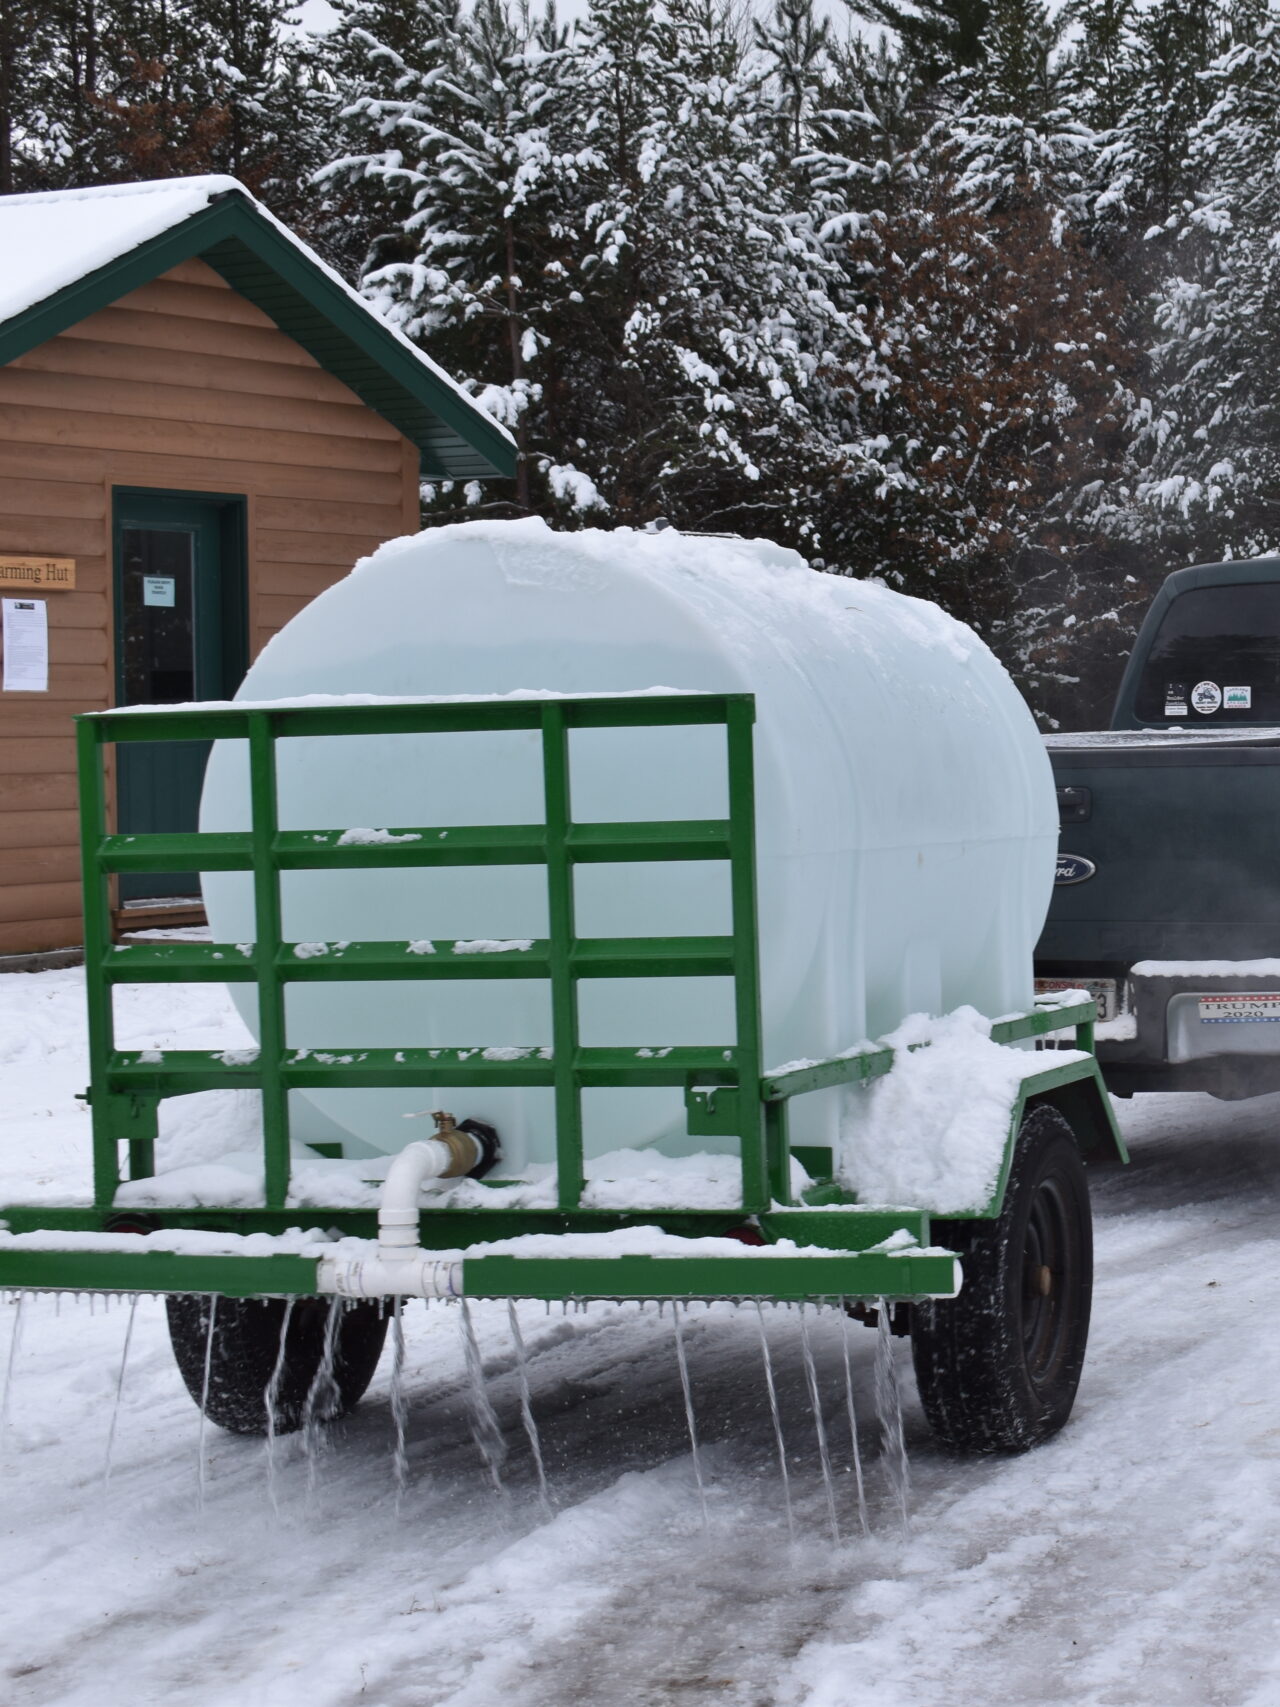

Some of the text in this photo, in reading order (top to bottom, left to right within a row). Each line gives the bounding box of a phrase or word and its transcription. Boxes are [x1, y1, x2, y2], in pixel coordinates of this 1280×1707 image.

[0, 563, 69, 584] arming Hut
[1223, 1010, 1264, 1019] 2020
